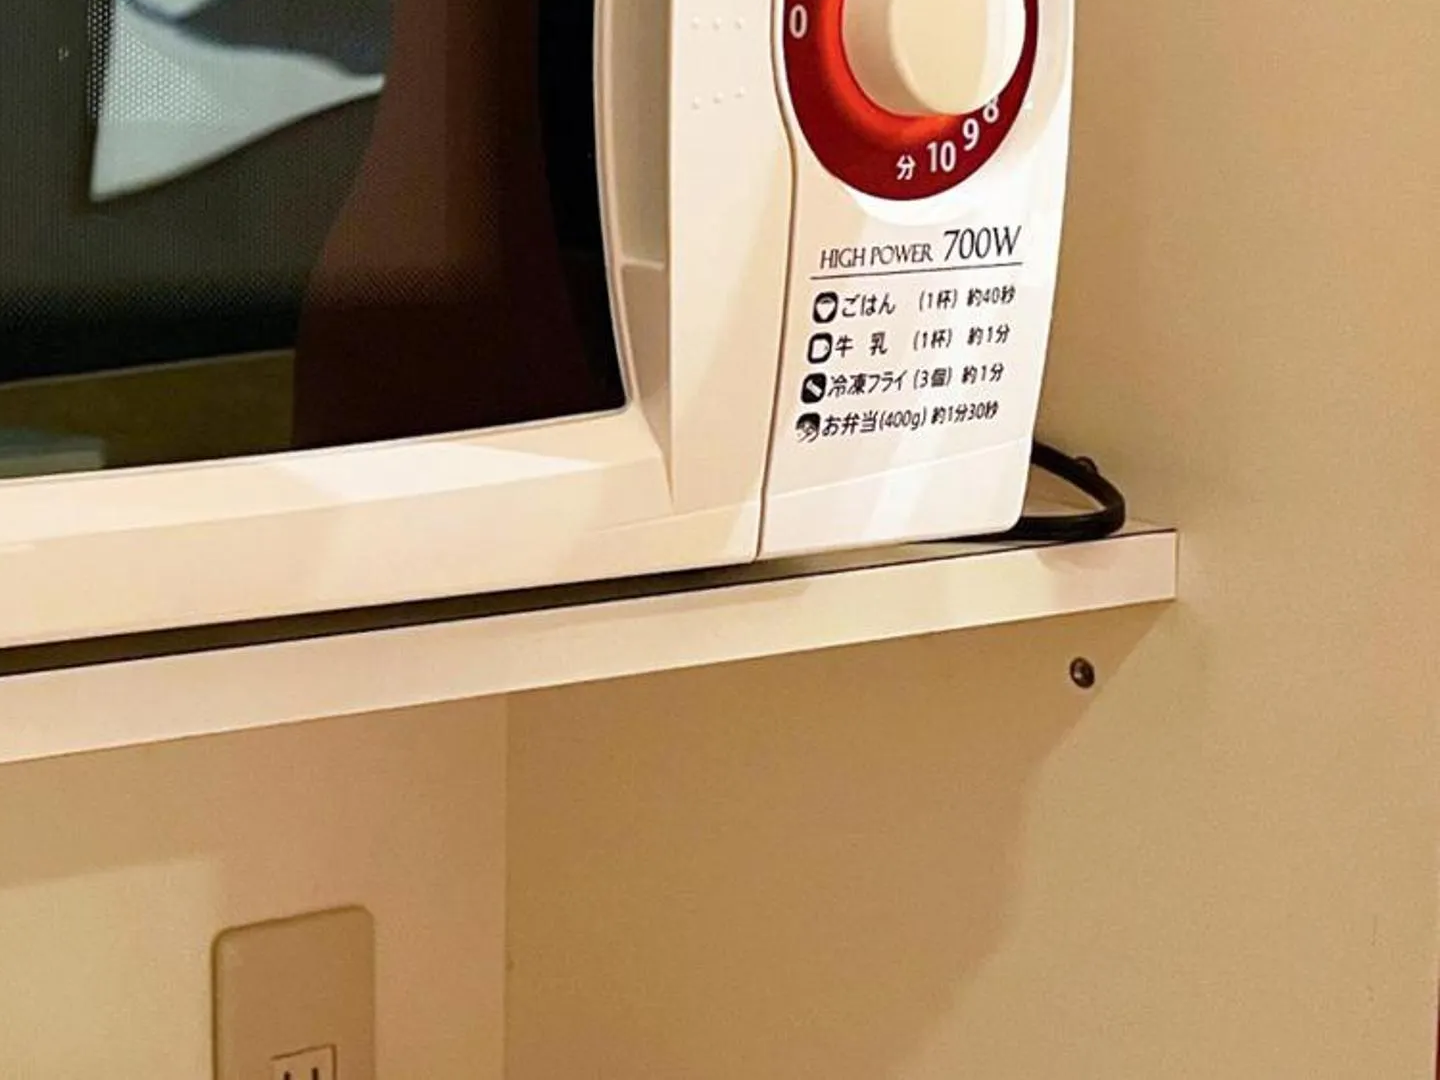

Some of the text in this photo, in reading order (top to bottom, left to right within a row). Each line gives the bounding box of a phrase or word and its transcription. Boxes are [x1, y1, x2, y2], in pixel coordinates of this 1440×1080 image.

[789, 5, 808, 39] 0
[962, 117, 980, 152] 9
[895, 154, 916, 181] 分
[925, 139, 957, 173] 10
[819, 225, 1023, 270] HIGH POWER 700W
[841, 284, 1016, 318] ごはん (1杯) 約40秒
[912, 327, 953, 351] (1杯)
[966, 323, 1011, 347] 約1分
[827, 362, 1005, 397] 冷凍フライ (3個) 約1分
[930, 400, 1000, 425] 約1分30秒
